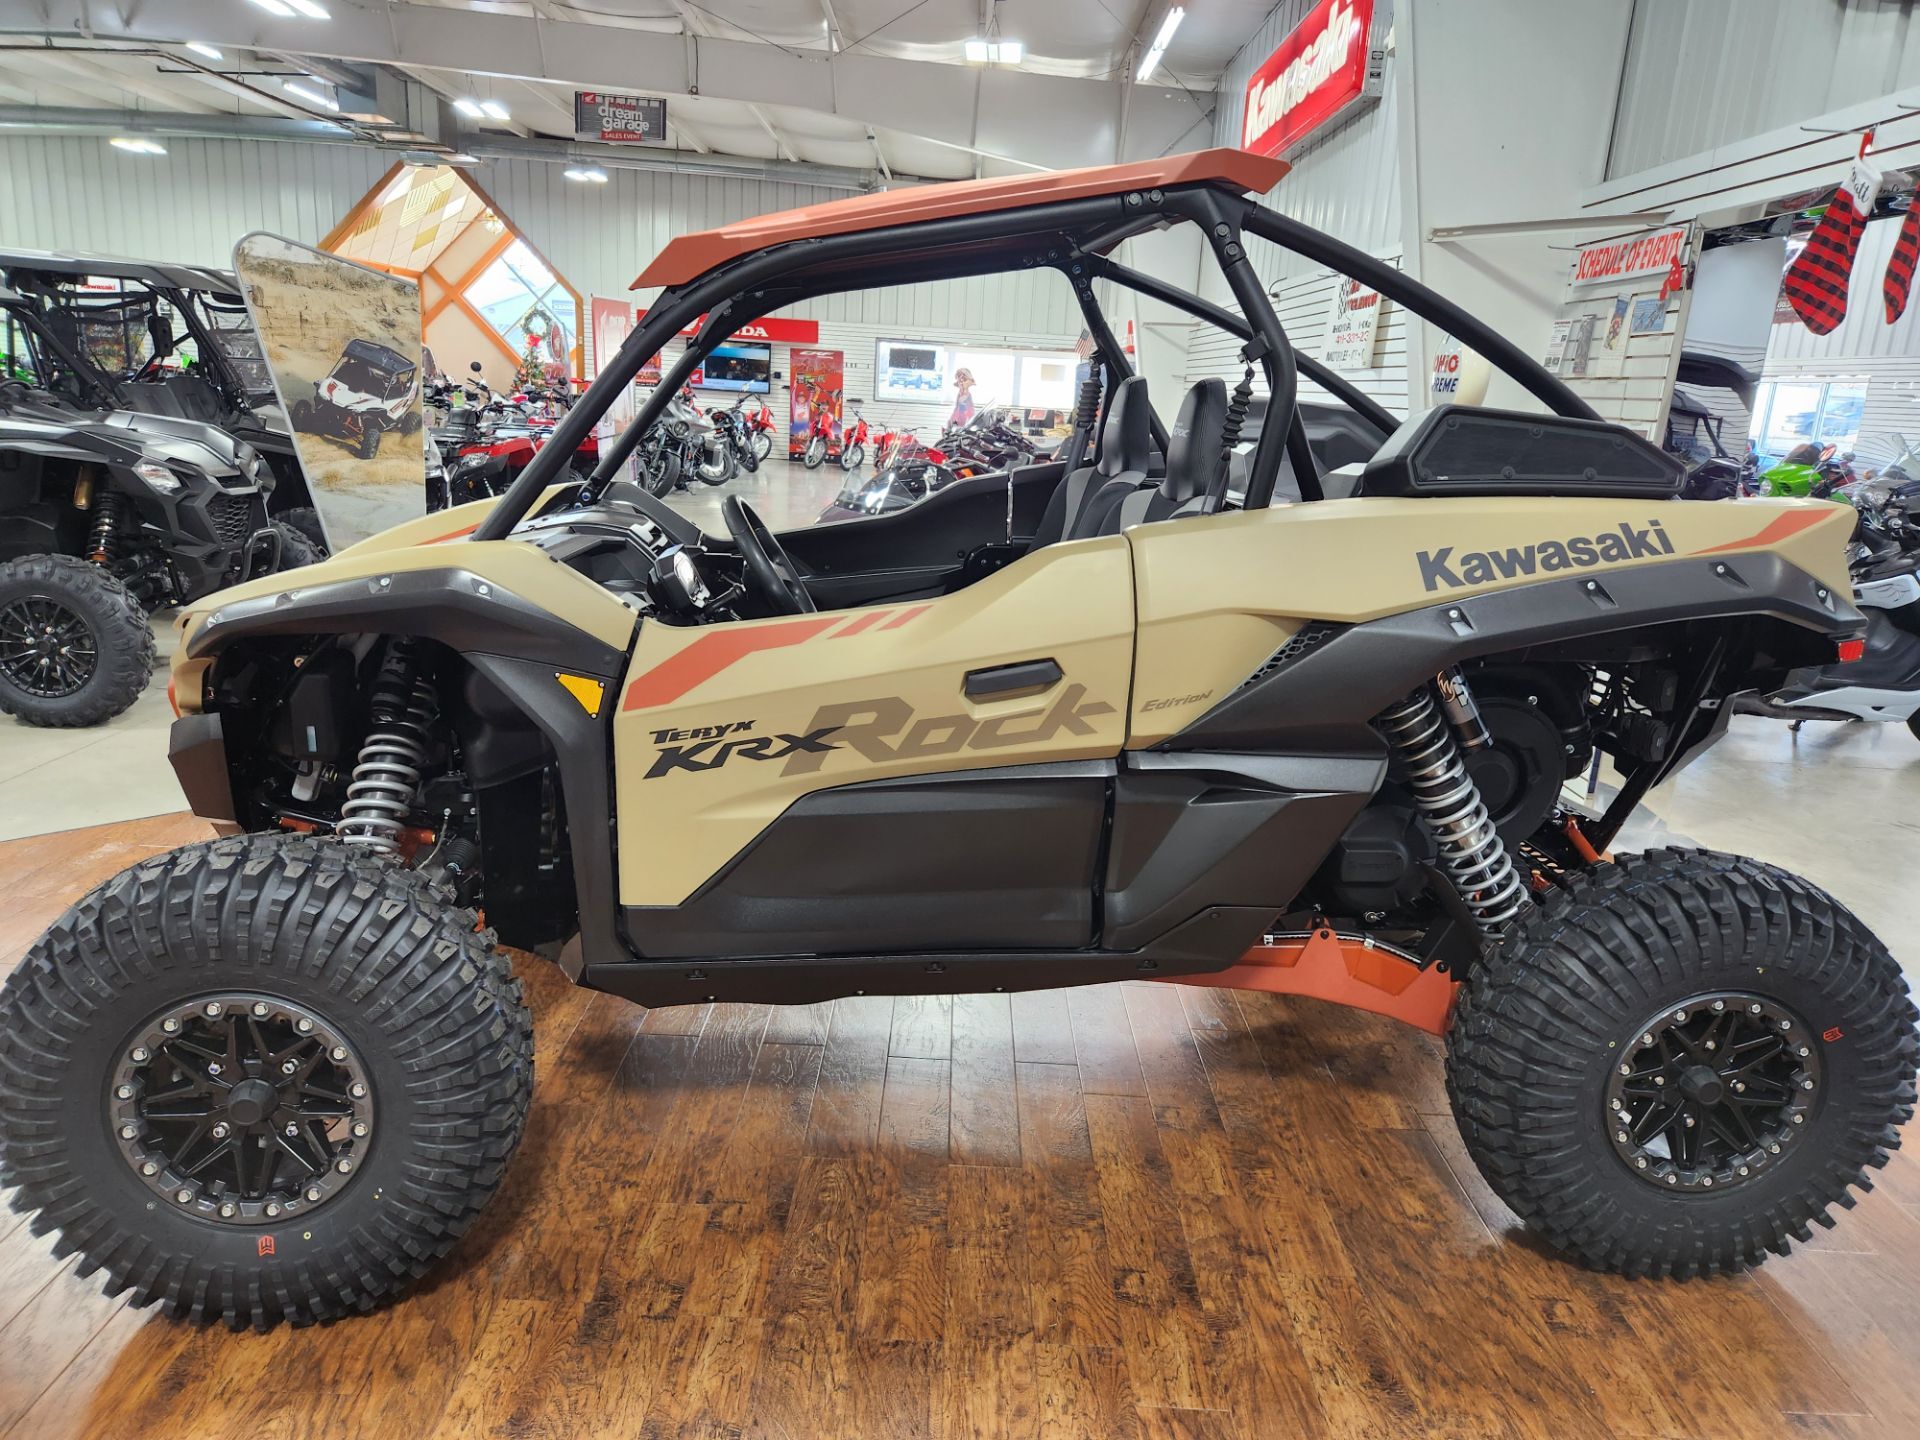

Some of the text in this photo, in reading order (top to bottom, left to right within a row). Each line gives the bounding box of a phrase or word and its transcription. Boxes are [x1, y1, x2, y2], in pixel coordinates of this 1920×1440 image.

[1245, 0, 1354, 149] Kawasaki
[598, 100, 642, 121] dream
[602, 117, 649, 134] garage
[1576, 243, 1629, 280] SCHEDULE
[1625, 239, 1645, 272] OF
[1416, 519, 1675, 592] Kawasaki
[1140, 689, 1215, 714] Edition
[642, 683, 1119, 780] KRX Rock
